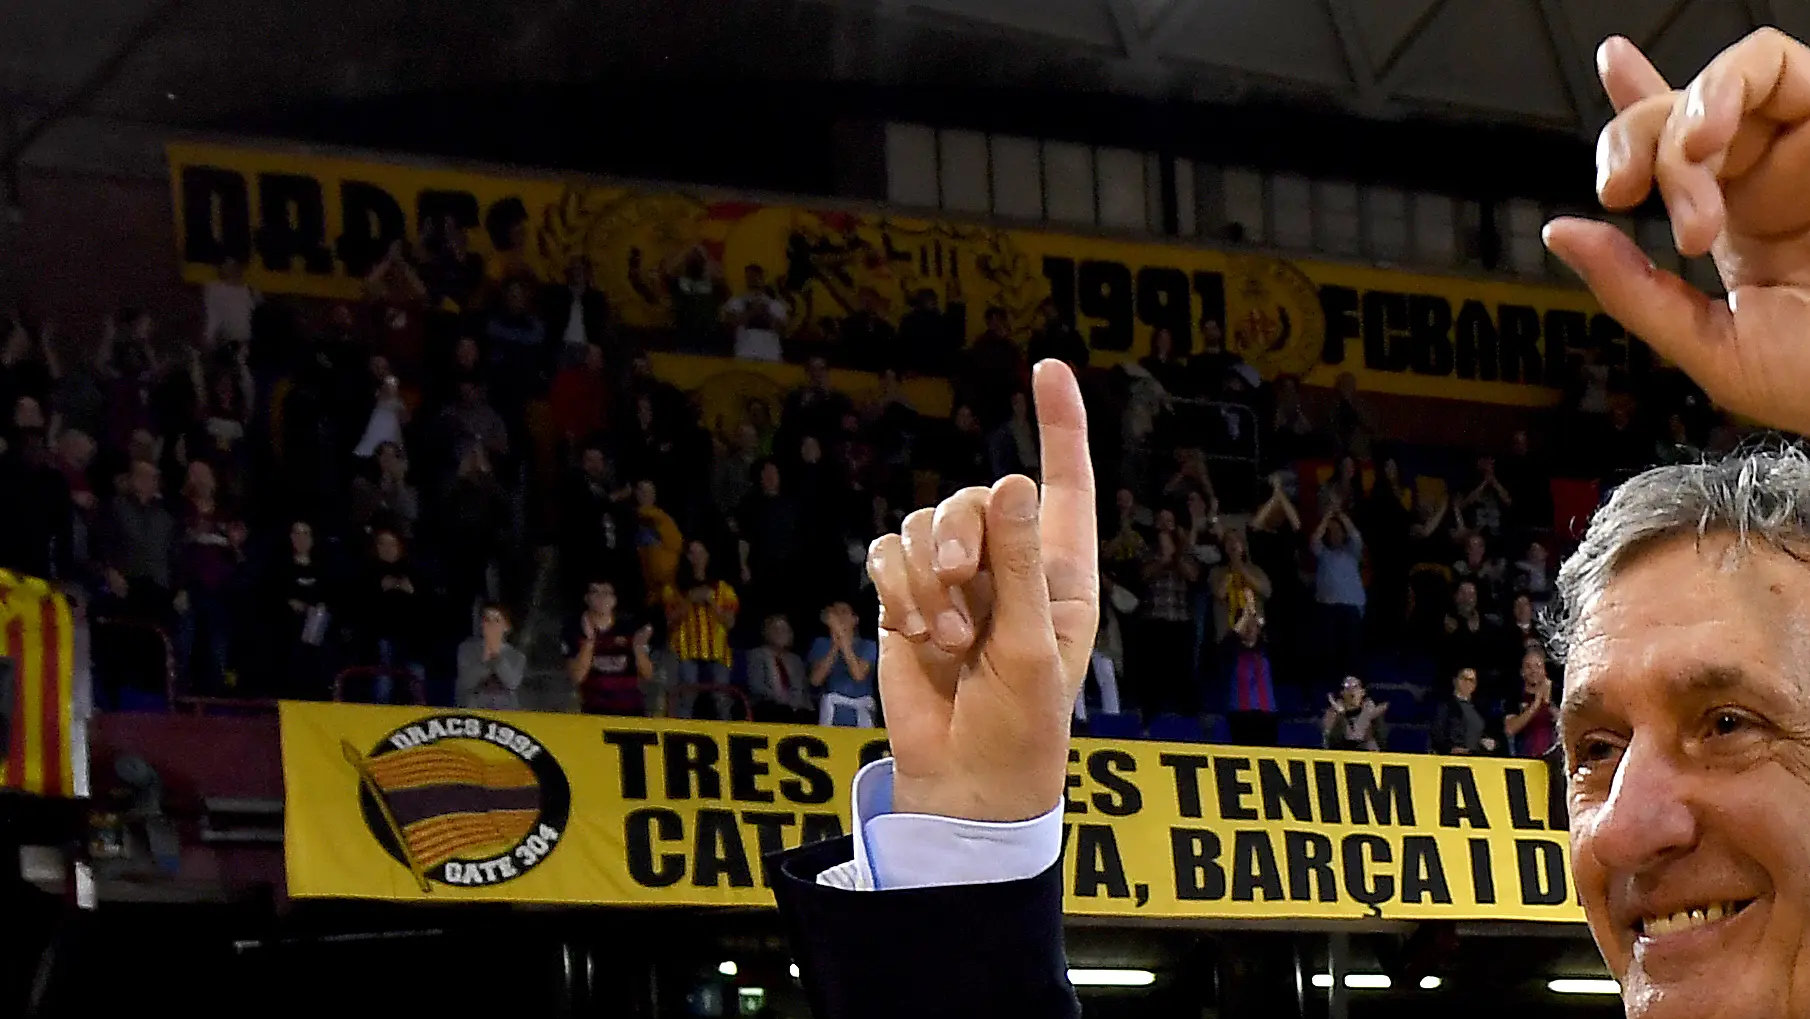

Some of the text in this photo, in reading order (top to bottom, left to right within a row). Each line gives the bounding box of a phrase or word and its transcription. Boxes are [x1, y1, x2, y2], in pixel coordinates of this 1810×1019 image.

[1043, 256, 1226, 354] 1991
[389, 717, 542, 761] DRACS 1991
[603, 728, 831, 804] TRES
[1160, 751, 1416, 828] TENIM
[1439, 765, 1490, 829] A
[444, 822, 560, 884] GATE 304
[1171, 828, 1453, 915] BARÇA
[1469, 838, 1496, 904] I
